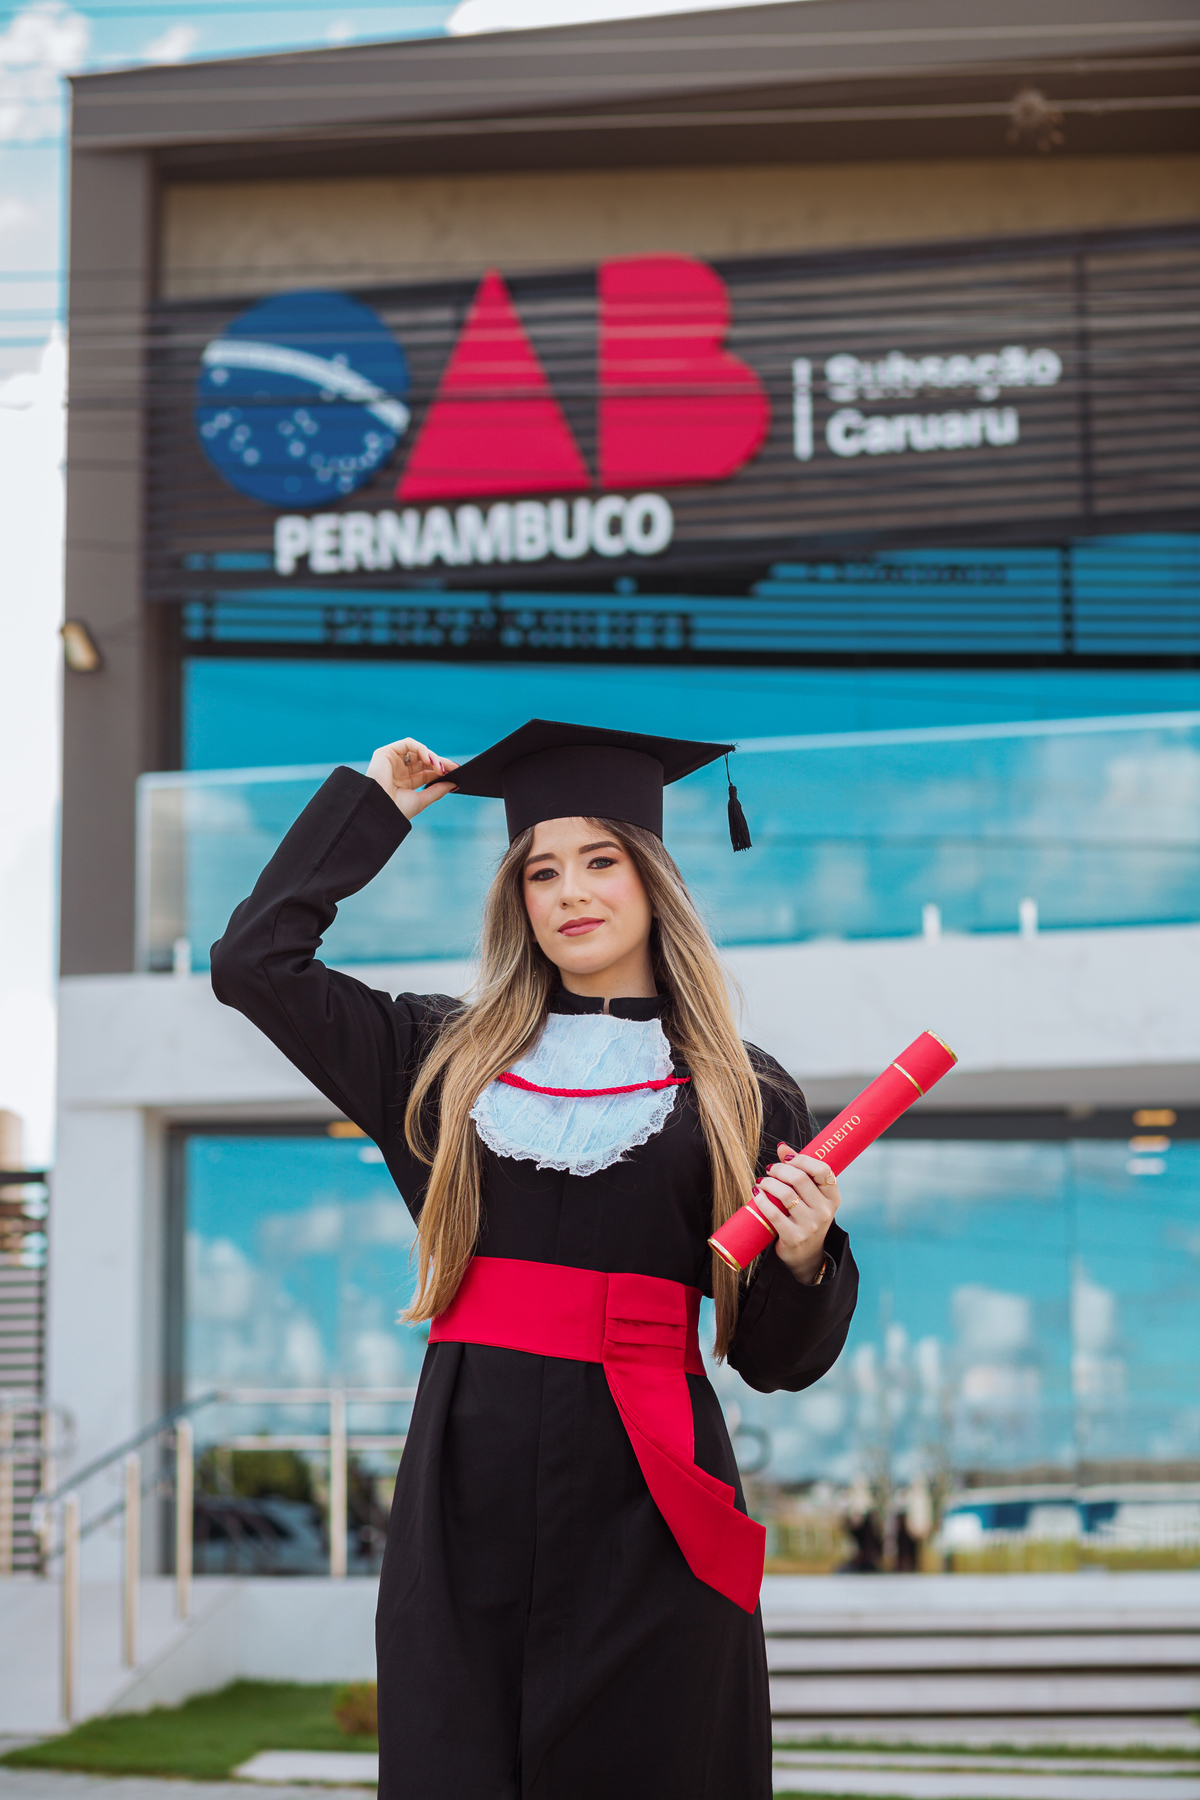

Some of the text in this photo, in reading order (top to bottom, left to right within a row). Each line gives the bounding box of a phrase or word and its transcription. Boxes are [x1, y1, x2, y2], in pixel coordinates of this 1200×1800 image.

[826, 407, 1019, 457] Caruaru
[275, 494, 673, 575] PERNAMBUCO
[814, 1115, 861, 1160] DIREITO
